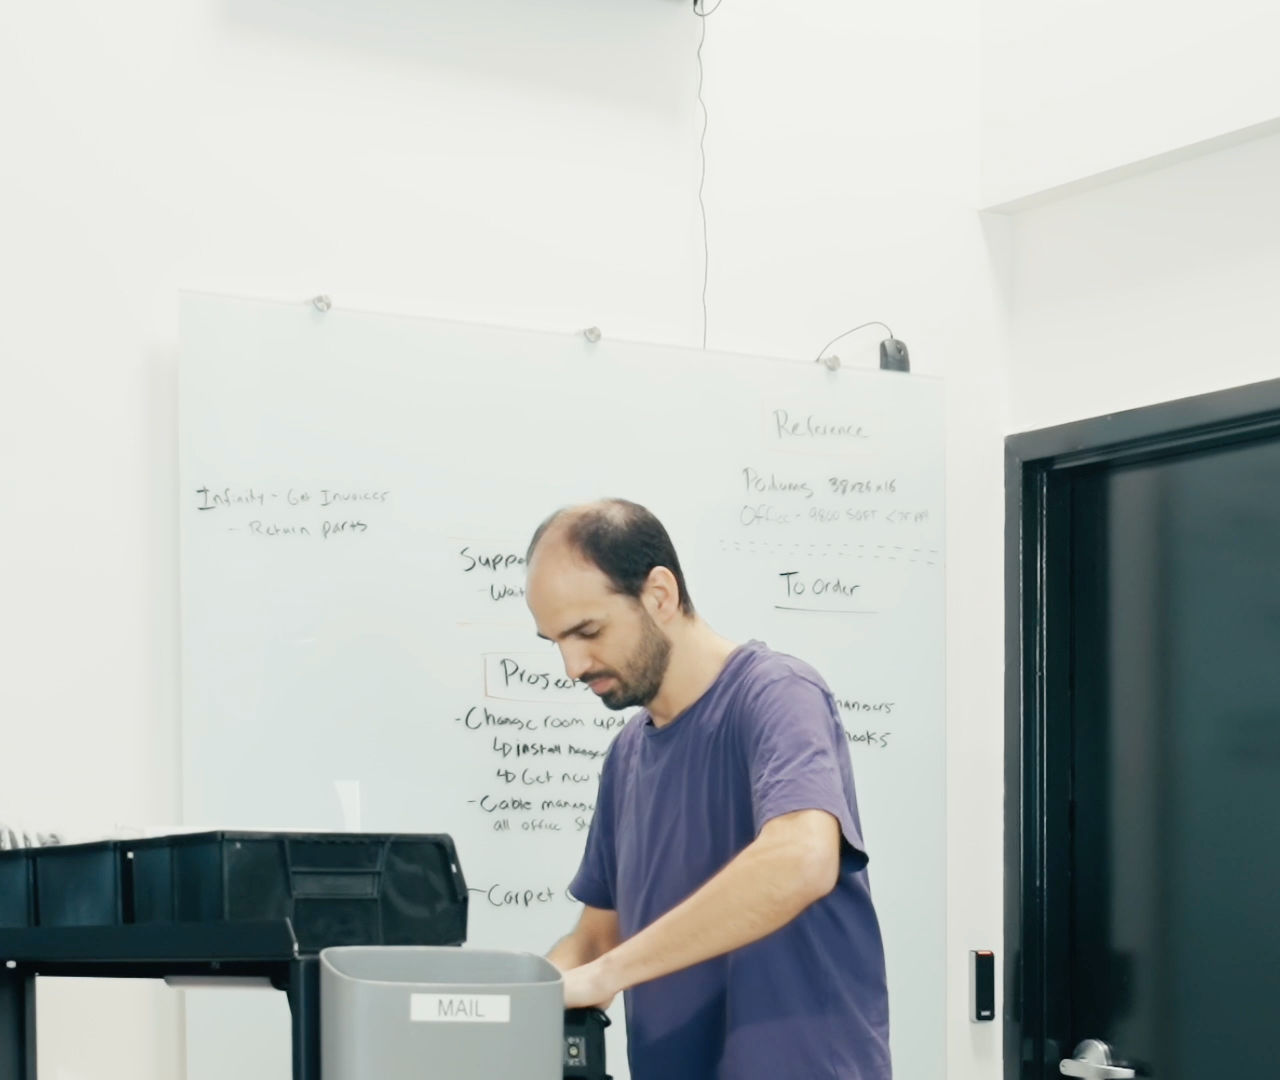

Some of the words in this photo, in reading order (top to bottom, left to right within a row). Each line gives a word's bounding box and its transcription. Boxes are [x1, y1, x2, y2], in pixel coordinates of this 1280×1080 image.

[773, 409, 870, 439] Reference
[196, 486, 265, 510] Infinity
[287, 488, 312, 506] Get
[320, 490, 391, 507] Invoices
[249, 520, 311, 536] Return
[322, 519, 368, 539] parts
[460, 546, 527, 571] Suppo
[779, 571, 806, 597] To
[811, 578, 861, 597] Order
[544, 716, 586, 728] room
[521, 768, 554, 785] Get
[493, 818, 511, 832] all
[521, 818, 562, 832] office
[438, 999, 486, 1017] MAIL
